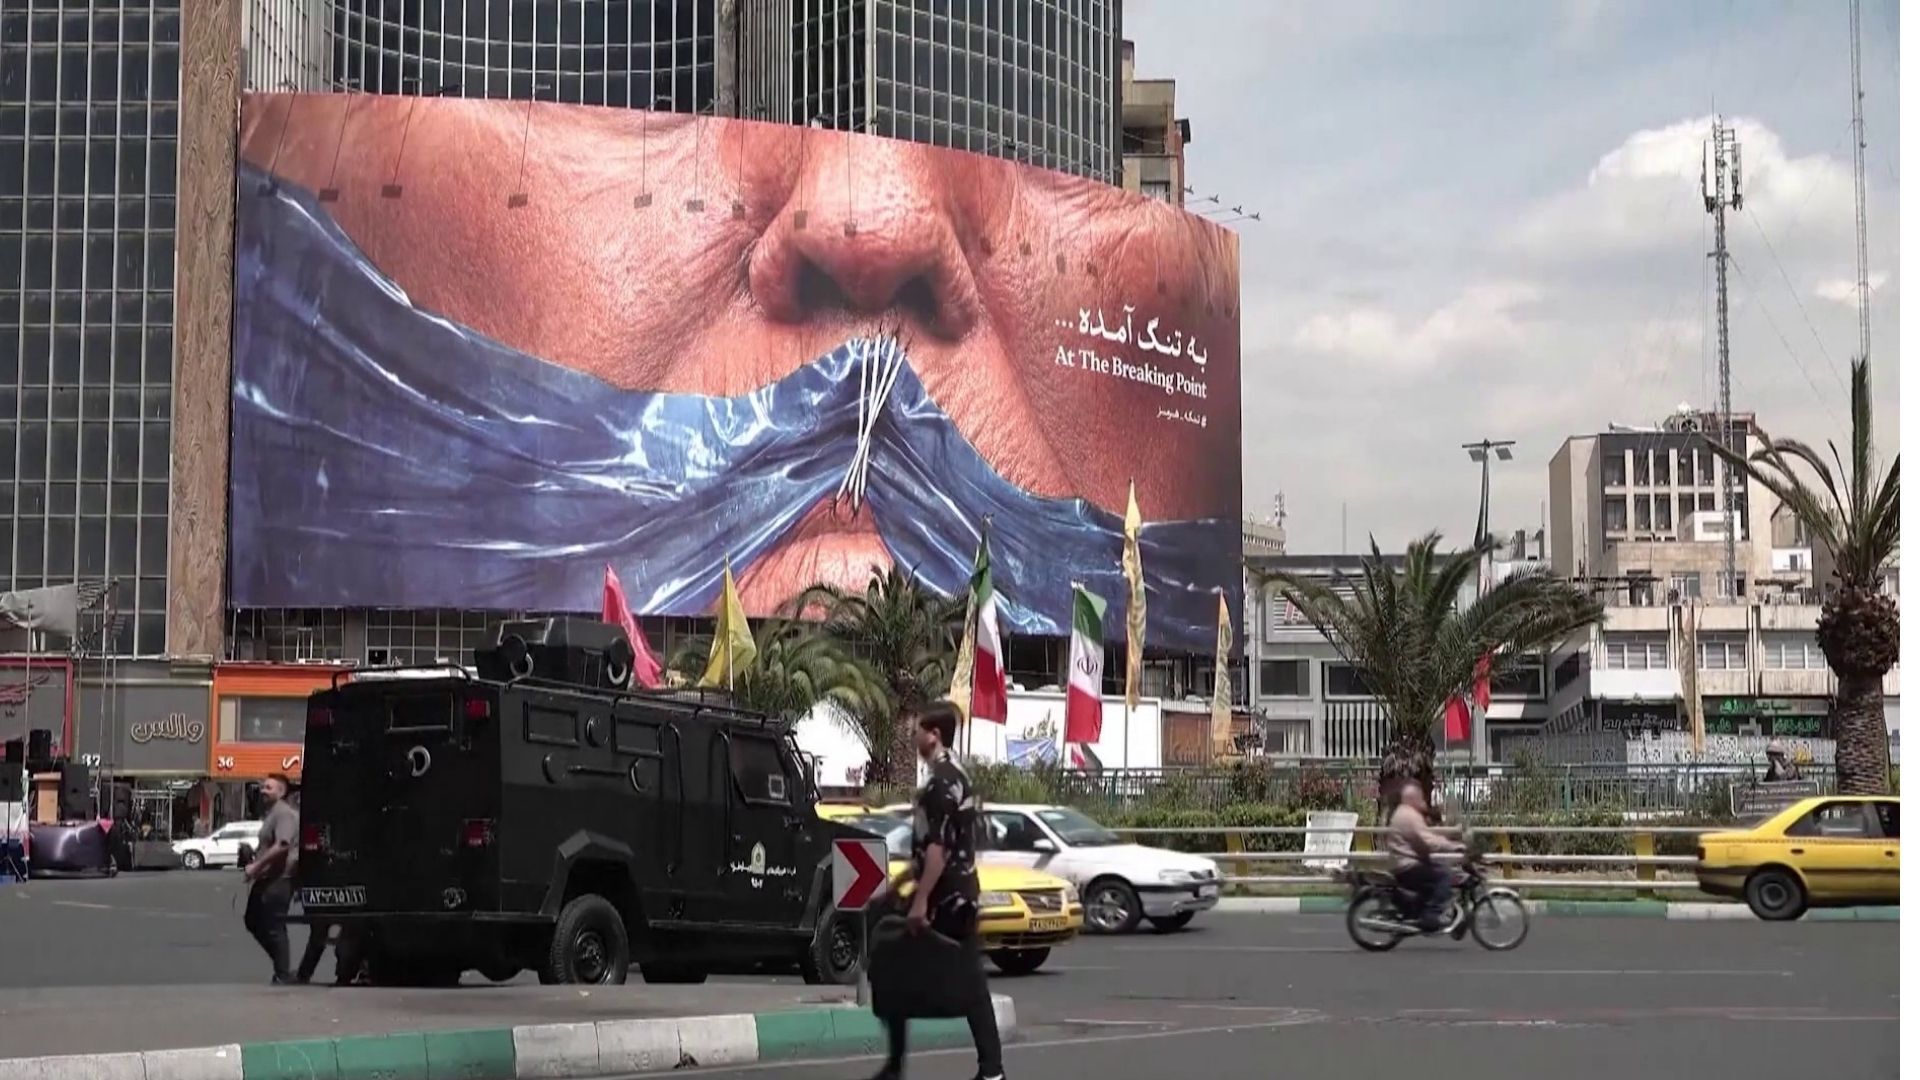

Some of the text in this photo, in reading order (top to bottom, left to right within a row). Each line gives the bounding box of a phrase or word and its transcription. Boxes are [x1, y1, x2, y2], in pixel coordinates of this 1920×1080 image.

[1079, 304, 1135, 344] آمده
[1137, 317, 1182, 357] تنگ
[1055, 345, 1207, 398] At The Breaking Point
[1187, 335, 1207, 373] به
[217, 755, 235, 769] 36
